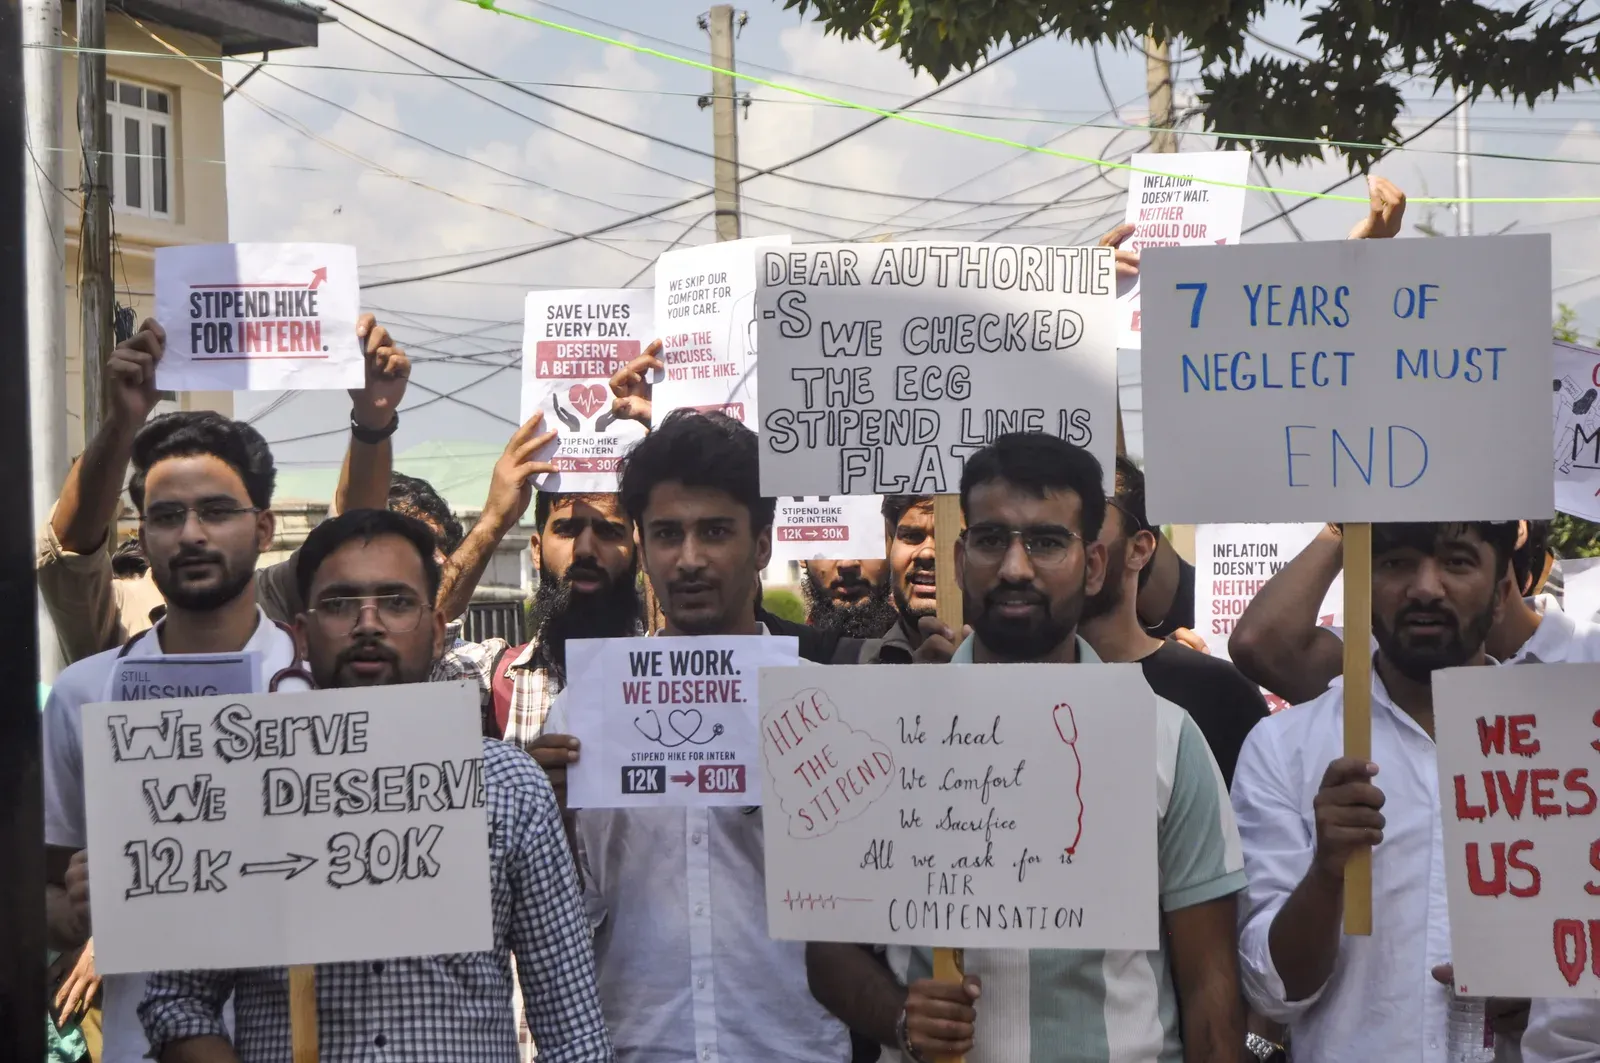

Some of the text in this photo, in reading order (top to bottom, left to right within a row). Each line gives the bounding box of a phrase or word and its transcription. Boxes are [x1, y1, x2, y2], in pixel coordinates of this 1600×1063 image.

[1143, 174, 1194, 189] INFLATION
[1141, 189, 1209, 204] DOESN'T WAIT.
[1139, 206, 1184, 221] NEITHER
[1133, 223, 1207, 239] SHOULD OUR
[669, 271, 727, 292] WE SKIP OUR
[764, 246, 1112, 296] DEAR AUTHORITIE
[189, 289, 319, 319] STIPEND HIKE
[667, 285, 732, 306] COMFORT FOR
[1175, 282, 1440, 329] 7 YEARS OF
[546, 303, 631, 320] SAVE LIVES
[667, 301, 720, 319] YOUR CARE.
[191, 320, 329, 354] FOR INTERN.
[545, 322, 631, 338] EVERY DAY.
[664, 330, 712, 349] SKIP THE
[821, 319, 883, 358] WE
[902, 308, 1085, 356] CHECKED
[556, 343, 618, 358] DESERVE
[665, 348, 716, 365] EXCUSES,
[539, 360, 630, 376] A BETTER PA
[668, 362, 740, 381] NOT THE HIKE.
[1180, 346, 1508, 393] NEGLECT MUST
[791, 364, 972, 410] THE ECG
[719, 405, 742, 420] 0K
[764, 407, 941, 454] STIPEND
[1059, 408, 1093, 449] IS
[556, 437, 618, 446] STIPEND HIKE
[561, 446, 614, 455] FOR INTERN
[556, 459, 619, 471] 12K 30K
[1284, 424, 1429, 489] END
[782, 506, 843, 515] STIPEND HIKE
[787, 515, 838, 524] FOR INTERN
[782, 527, 844, 540] 12K 30K
[1212, 543, 1279, 558] INFLATION
[1212, 561, 1265, 576] DOESN'T
[629, 649, 742, 677] WE WORK.
[121, 671, 151, 682] STILL
[121, 684, 219, 702] MISSING
[622, 679, 748, 705] WE DESERVE.
[765, 692, 832, 757] HIKE
[896, 714, 1005, 747] We heal
[1475, 713, 1542, 759] WE
[631, 750, 736, 762] STIPEND HIKE FOR INTERN
[793, 743, 840, 788] THE
[261, 757, 486, 818] DESERVE
[627, 767, 740, 792] 12K 30K
[898, 766, 927, 791] We
[797, 750, 894, 832] STIPEND
[1452, 767, 1599, 824] LIVES
[898, 807, 923, 829] We
[123, 824, 445, 901] 12K 30K
[859, 838, 896, 871] All
[911, 853, 938, 870] we
[950, 845, 996, 870] ask
[1012, 847, 1042, 882] for
[1464, 838, 1542, 899] US
[926, 871, 975, 896] FAIR
[887, 898, 1085, 933] COMPENSATION
